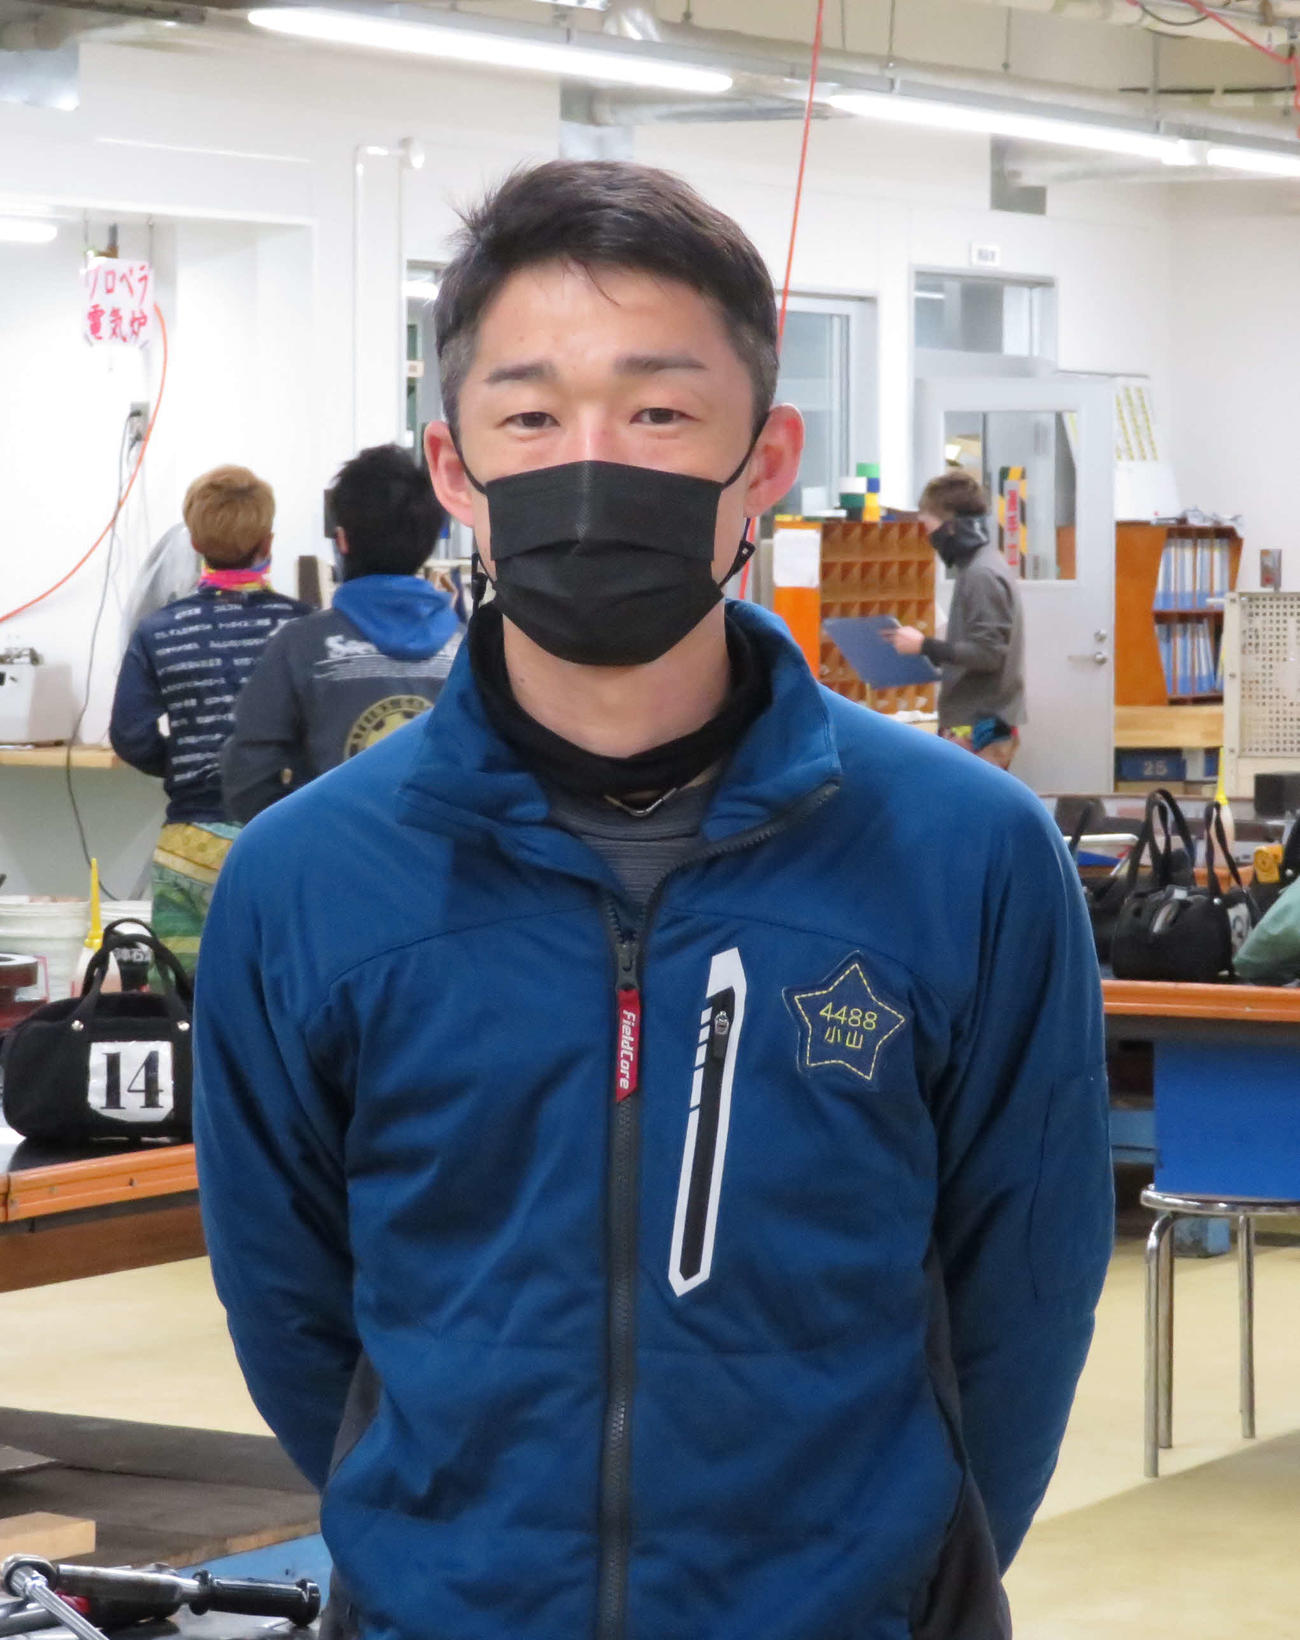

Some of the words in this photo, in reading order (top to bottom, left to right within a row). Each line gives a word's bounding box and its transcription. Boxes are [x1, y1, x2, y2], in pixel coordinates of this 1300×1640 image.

[818, 1001, 878, 1031] 4488
[824, 1026, 864, 1049] 小山
[619, 1009, 637, 1091] FieldCore
[100, 1050, 164, 1110] 14
